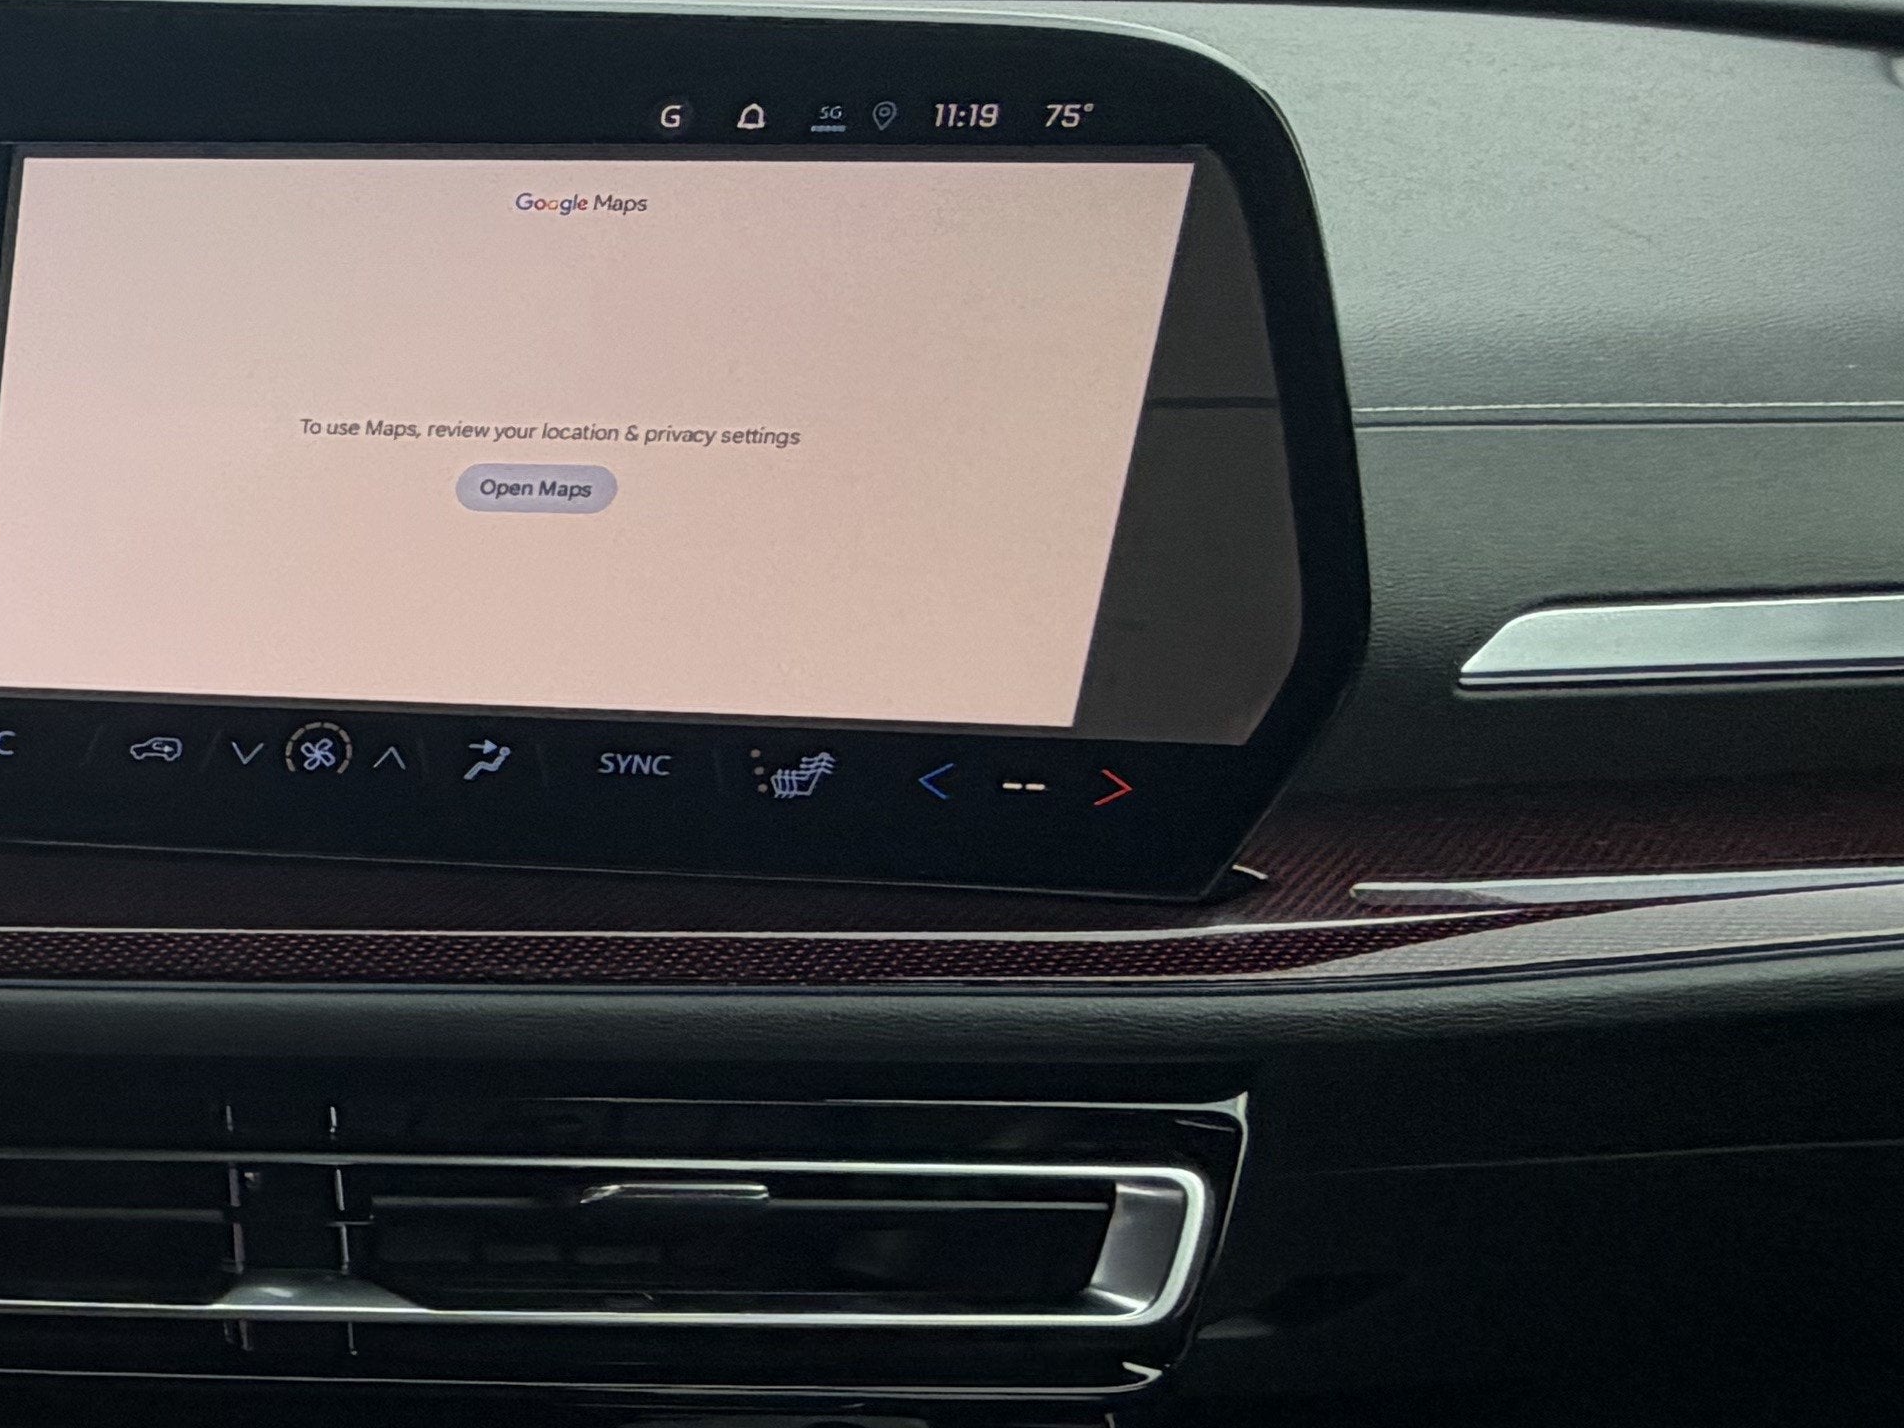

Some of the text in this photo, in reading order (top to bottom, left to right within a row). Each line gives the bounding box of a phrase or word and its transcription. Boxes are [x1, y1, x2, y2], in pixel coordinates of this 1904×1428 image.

[934, 102, 1000, 128] 11:19
[1044, 103, 1094, 128] 75°
[515, 192, 648, 216] Google Maps
[300, 419, 801, 449] To use Maps, review your location & privacy settings
[480, 478, 592, 500] Open Maps
[597, 752, 672, 776] SYNC
